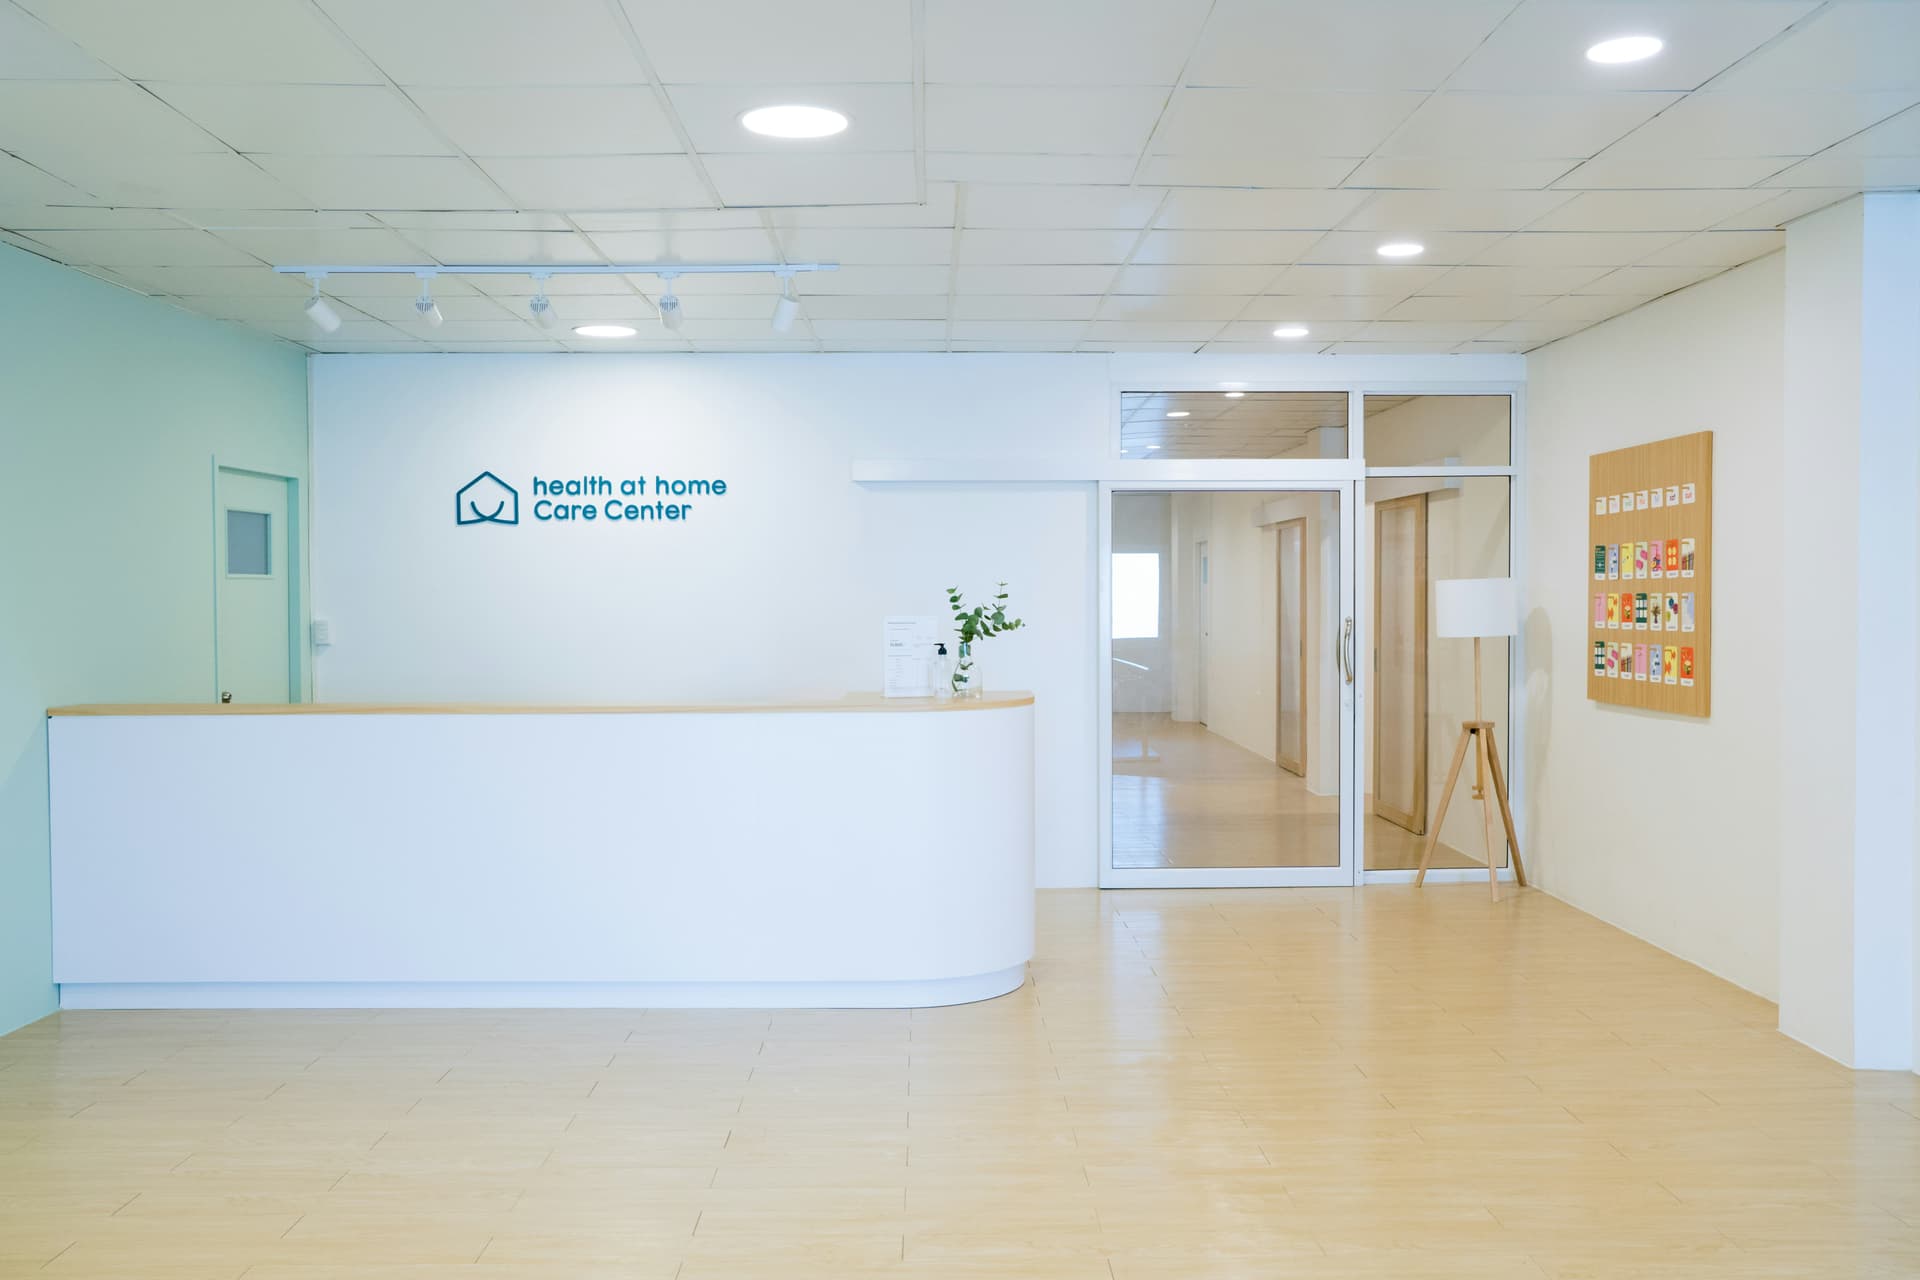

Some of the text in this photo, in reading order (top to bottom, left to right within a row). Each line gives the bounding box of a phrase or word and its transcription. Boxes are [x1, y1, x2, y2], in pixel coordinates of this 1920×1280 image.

[533, 475, 727, 496] health at home
[533, 499, 693, 521] Care Center
